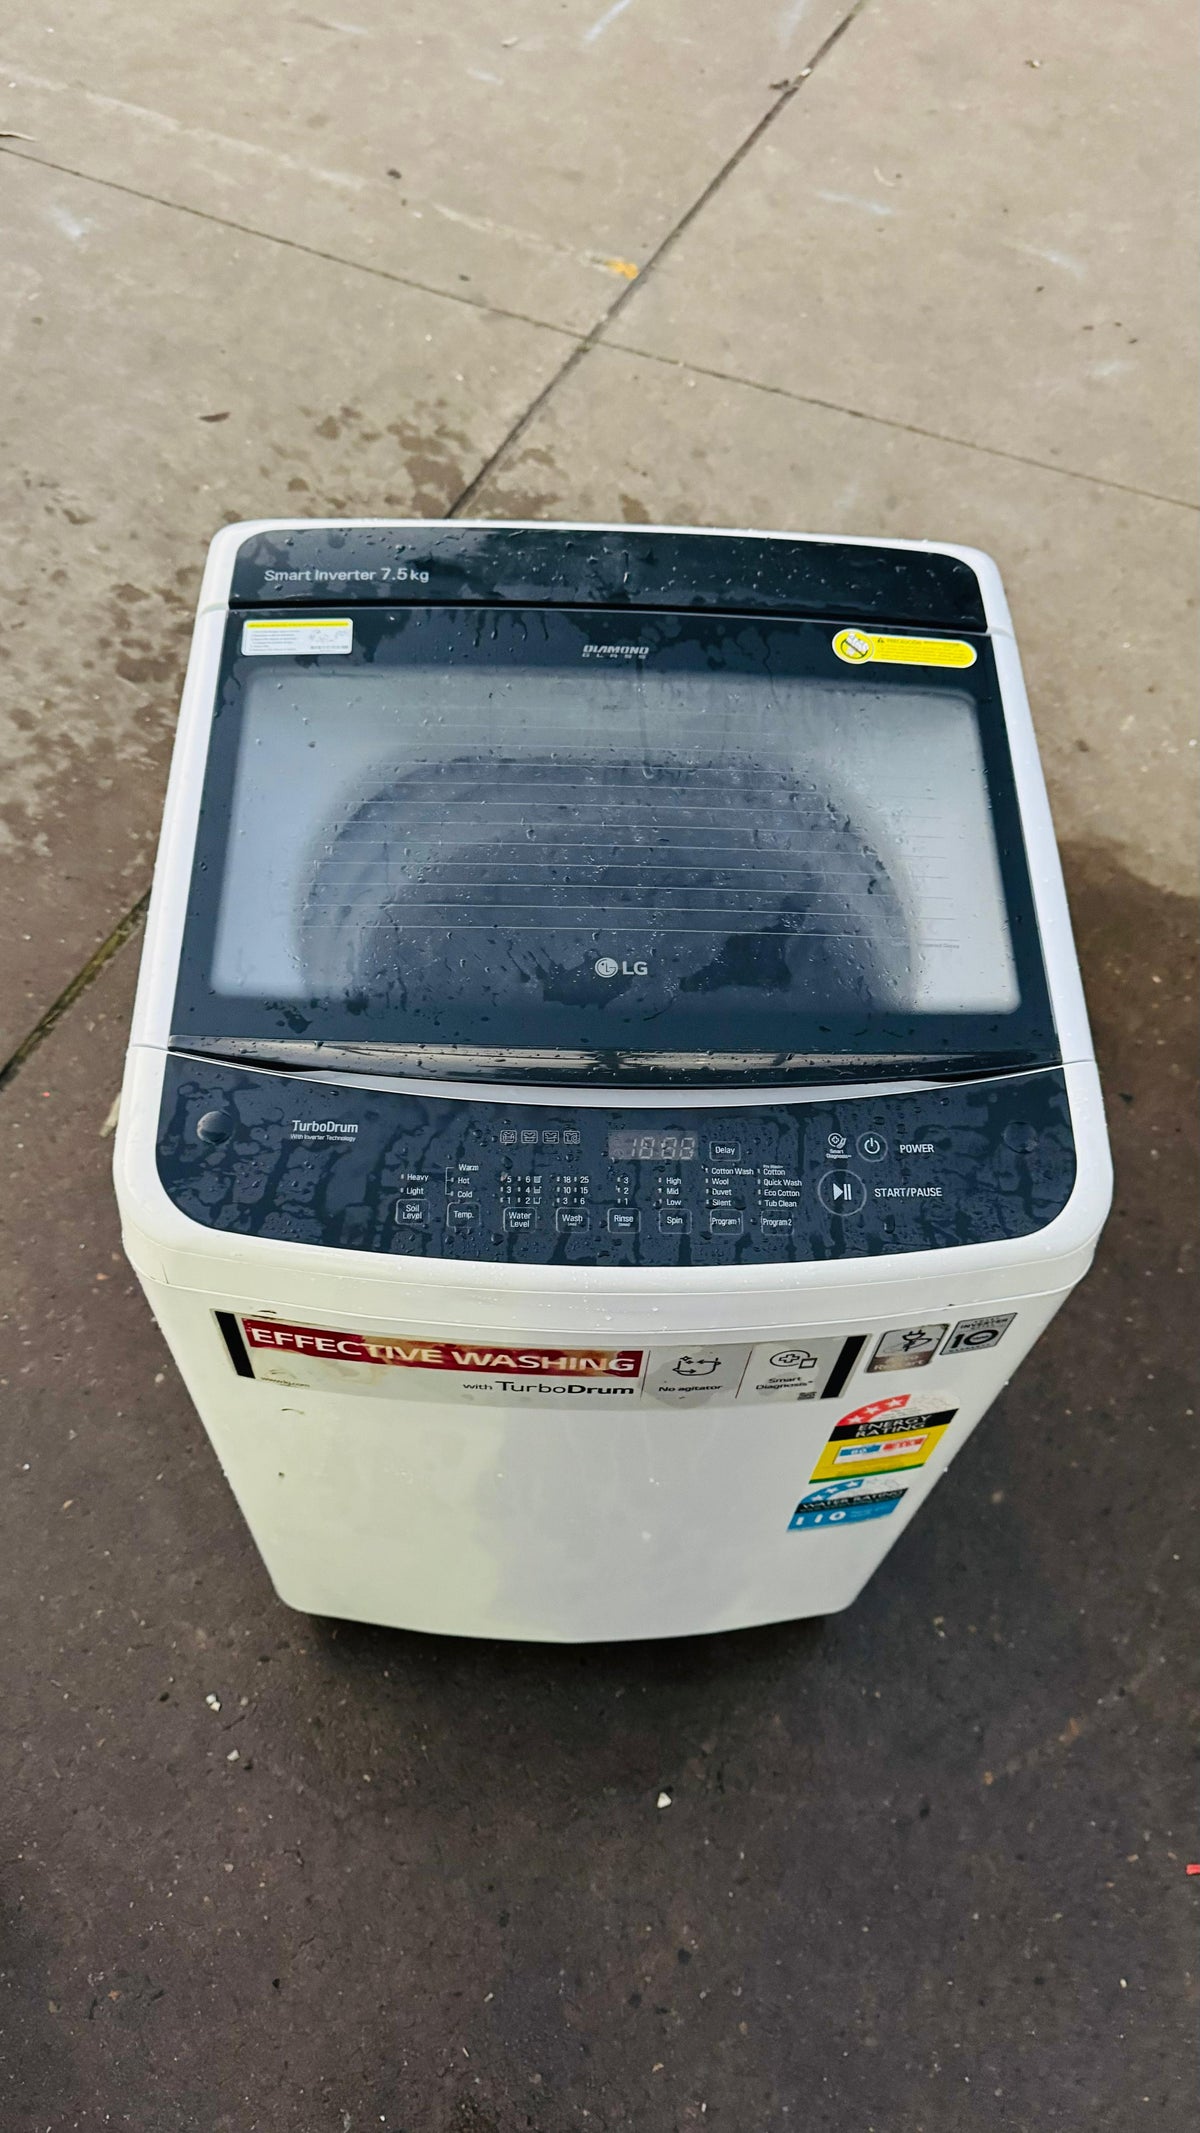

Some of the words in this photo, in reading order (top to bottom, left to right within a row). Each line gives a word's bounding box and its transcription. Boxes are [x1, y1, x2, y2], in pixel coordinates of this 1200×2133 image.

[264, 569, 311, 581] Smart
[315, 569, 376, 581] Inverter
[583, 645, 649, 654] DIAMOND
[622, 961, 648, 975] LG
[292, 1120, 358, 1133] TurboDrum
[715, 1146, 735, 1155] Delay
[900, 1144, 934, 1153] POWER
[666, 1177, 681, 1185] High
[874, 1187, 943, 1198] START/PAUSE
[507, 1197, 512, 1205] 1
[525, 1197, 531, 1205] 2
[563, 1197, 568, 1205] 3
[580, 1197, 585, 1205] 6
[405, 1204, 419, 1212] Soil
[402, 1212, 422, 1220] Level
[453, 1210, 474, 1219] Temp.
[508, 1212, 532, 1220] Water
[561, 1214, 583, 1222] Wash
[614, 1215, 634, 1223] Rinse
[510, 1220, 530, 1228] Level
[666, 1216, 683, 1225] Spin
[951, 1330, 999, 1349] 10
[251, 1327, 444, 1364] EFFECTIVE
[451, 1351, 636, 1372] WASHING
[463, 1383, 493, 1391] with
[495, 1381, 635, 1395] TurboDrum
[859, 1414, 933, 1431] ENERGY
[855, 1422, 926, 1438] RATING
[803, 1499, 849, 1509] WATER
